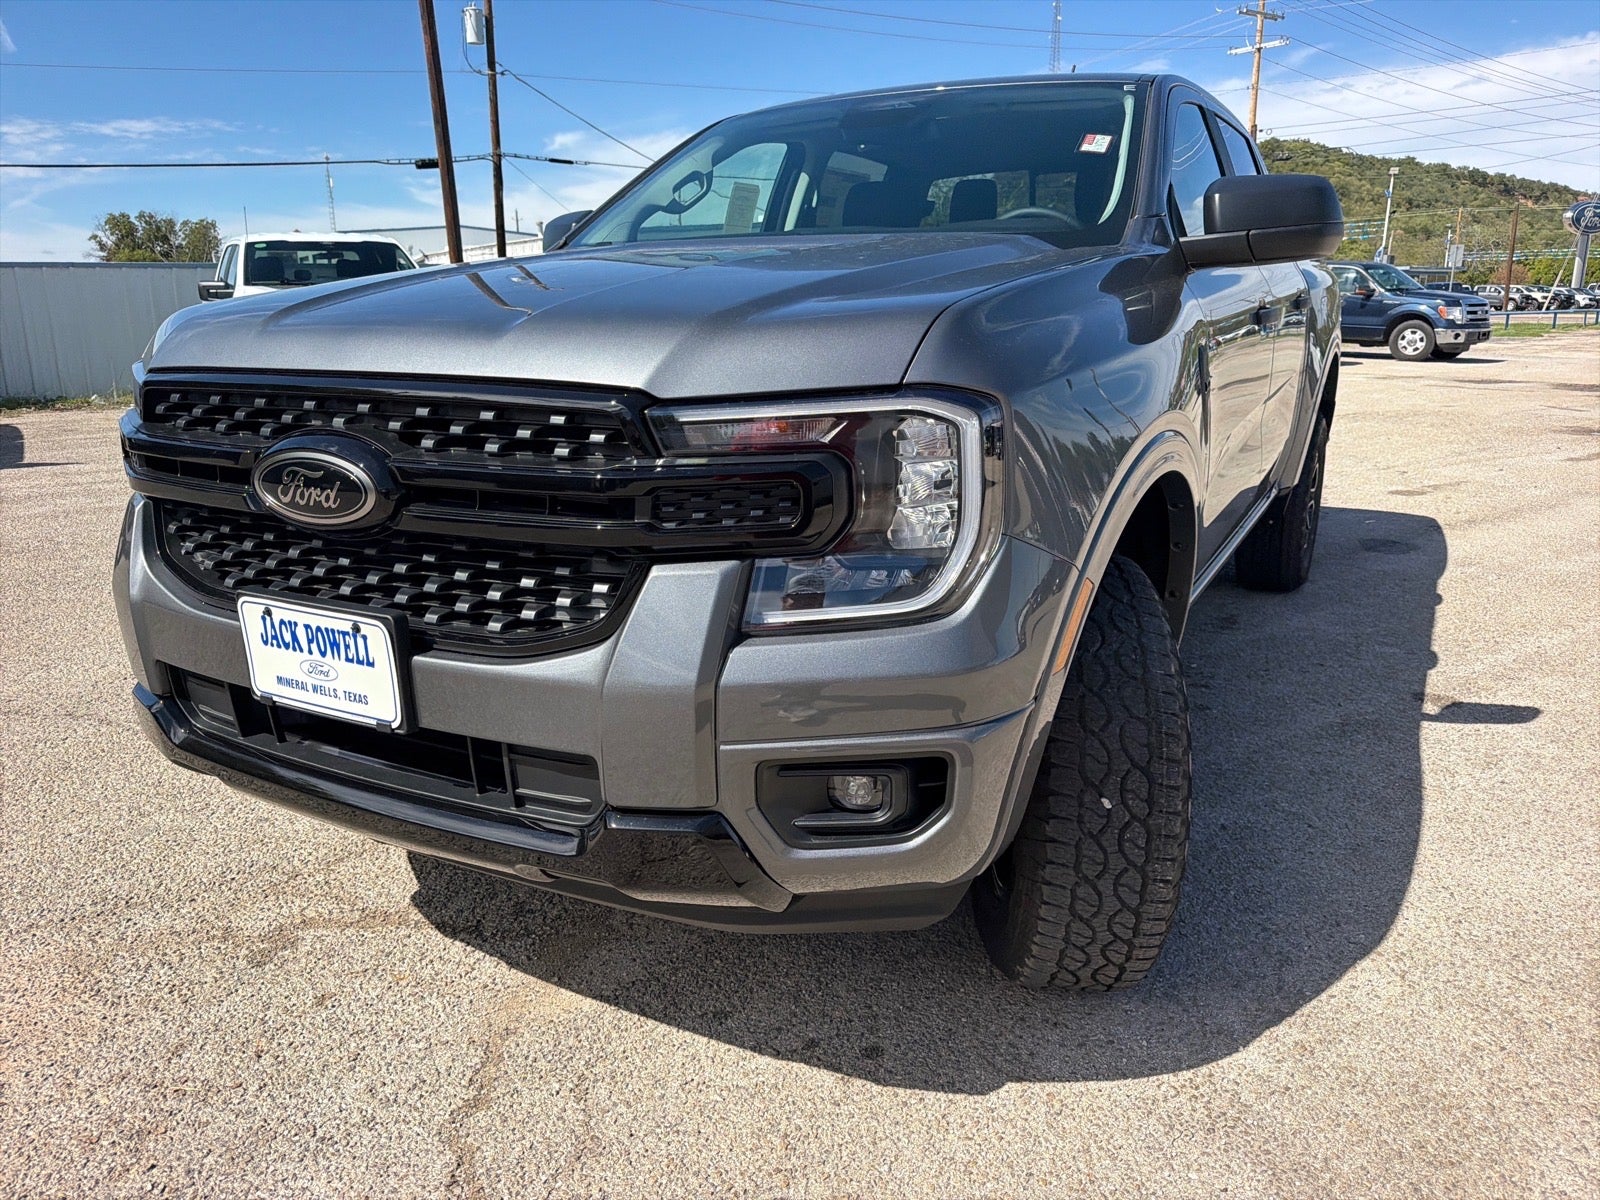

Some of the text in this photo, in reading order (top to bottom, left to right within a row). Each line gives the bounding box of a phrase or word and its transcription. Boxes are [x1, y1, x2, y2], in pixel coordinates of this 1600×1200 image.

[1580, 207, 1600, 227] For
[277, 466, 341, 508] Ford
[261, 614, 375, 668] JACK POWELL
[307, 661, 330, 678] Ford
[276, 675, 369, 706] MINERAL WELLS, TEXAS
